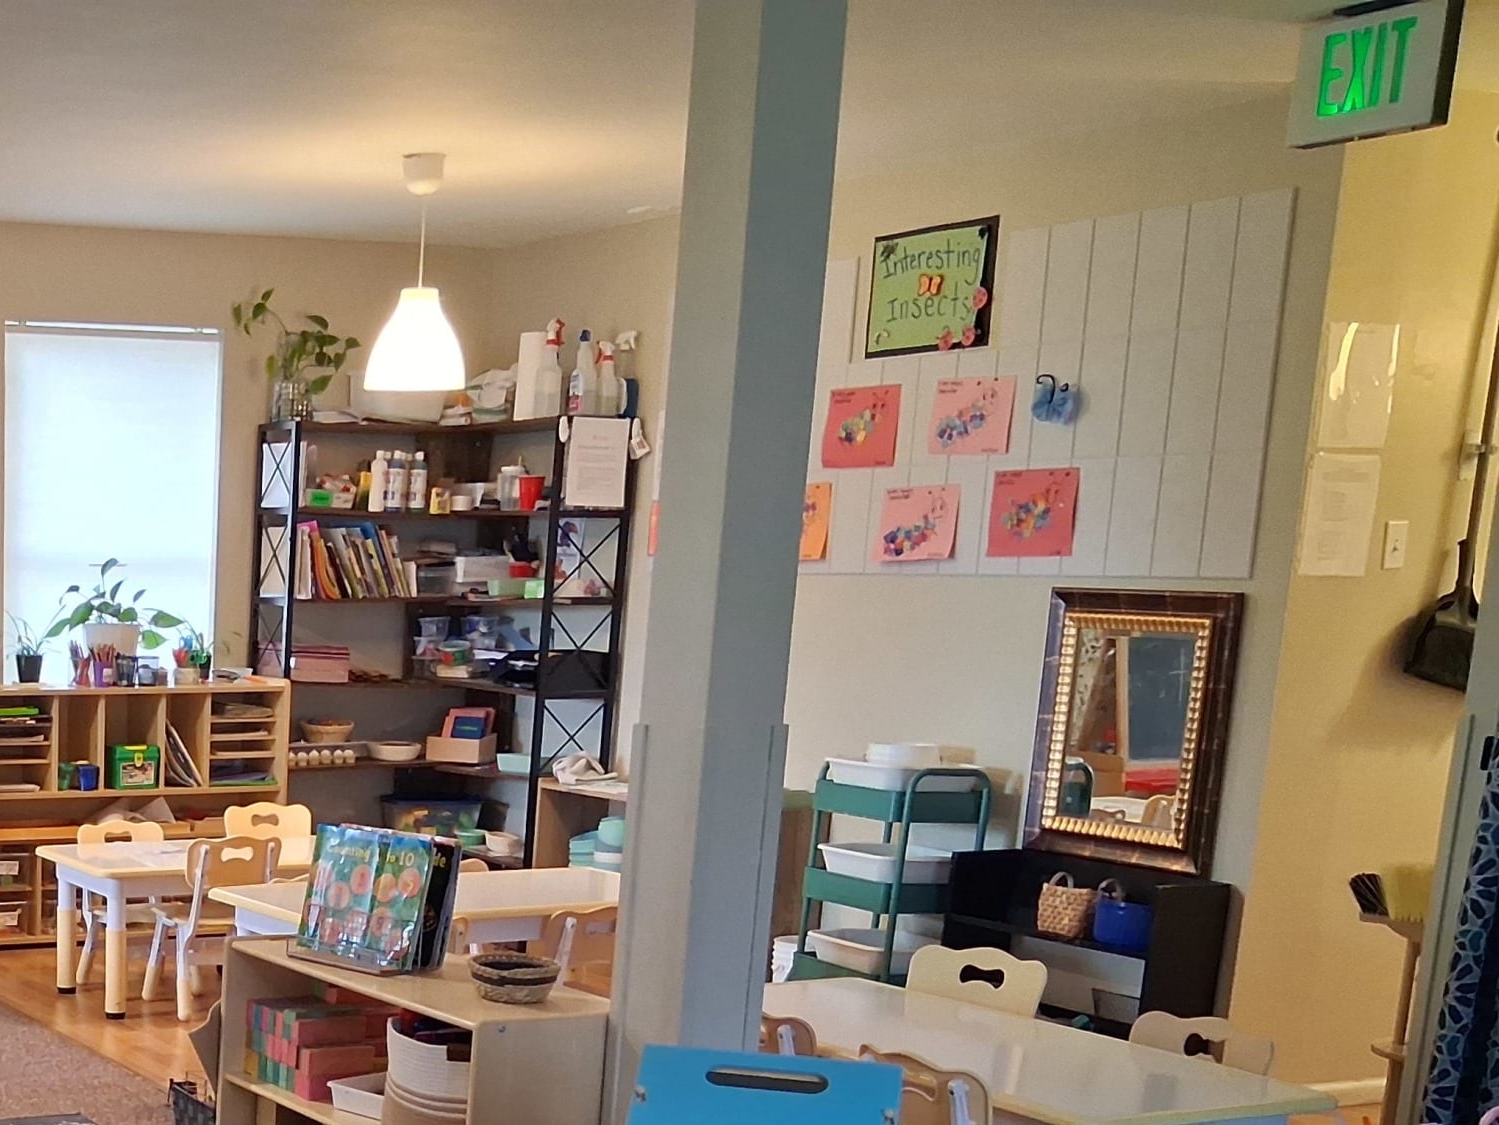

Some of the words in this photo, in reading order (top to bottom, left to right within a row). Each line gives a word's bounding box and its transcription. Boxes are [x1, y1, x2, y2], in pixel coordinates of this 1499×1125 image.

[1316, 16, 1419, 117] EXIT
[880, 238, 981, 286] Interesting
[886, 281, 972, 323] Insects
[399, 850, 415, 866] 10
